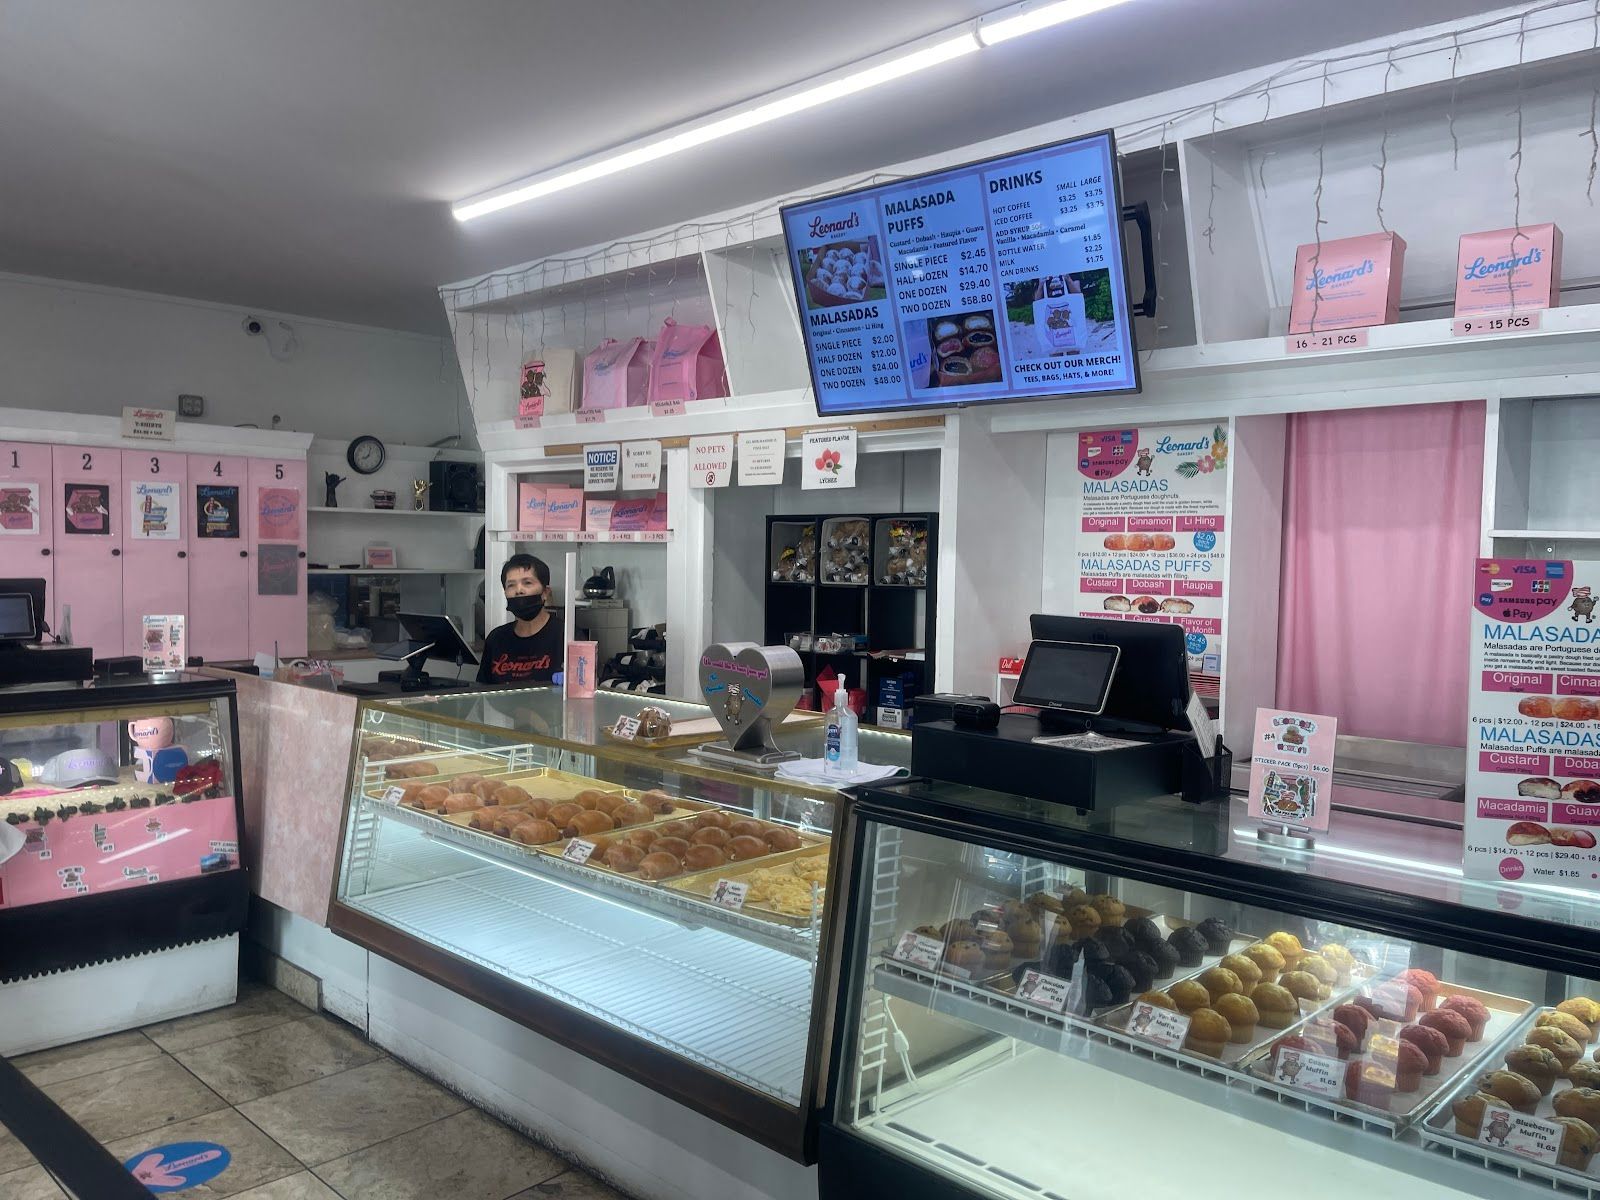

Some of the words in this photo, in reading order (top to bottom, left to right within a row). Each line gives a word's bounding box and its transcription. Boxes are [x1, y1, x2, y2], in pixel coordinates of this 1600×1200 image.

[989, 170, 1043, 194] DRINKS
[1056, 181, 1077, 191] SMALL
[1080, 176, 1101, 186] LARGE
[885, 190, 955, 216] MALASADA
[992, 206, 1006, 214] HOT
[1007, 201, 1031, 211] COFFEE
[1059, 194, 1076, 203] $3.25
[1084, 188, 1103, 198] $3.75
[994, 217, 1008, 226] ICED
[1009, 212, 1033, 223] COFFEE
[1060, 205, 1078, 215] $3.25
[808, 211, 859, 238] Leonard's
[888, 216, 924, 234] PUFFS
[995, 229, 1009, 238] ADD
[1010, 225, 1030, 235] SYRUP
[890, 238, 911, 248] Custard
[966, 225, 984, 234] Guava
[996, 236, 1016, 245] Vanilla
[1021, 229, 1055, 240] Macadamia
[1060, 224, 1086, 234] Caramel
[933, 239, 958, 249] Featured
[998, 246, 1022, 257] BOTTLE
[1022, 243, 1045, 253] WATER
[894, 259, 923, 272] SINGLE
[925, 254, 948, 266] PIECE
[960, 248, 986, 260] $2.45
[999, 258, 1015, 267] MILK
[1084, 244, 1103, 253] $2.25
[1000, 268, 1014, 277] CAN
[1015, 265, 1039, 275] DRINKS
[1086, 255, 1104, 263] $1.75
[1464, 248, 1542, 280] Leonard's
[920, 270, 948, 282] DOZEN
[959, 263, 989, 276] $14.70
[1306, 259, 1373, 290] Leonard's
[899, 289, 916, 300] ONE
[918, 285, 947, 297] DOZEN
[960, 278, 991, 291] $29.40
[901, 304, 920, 314] TWO
[922, 299, 951, 311] DOZEN
[961, 293, 993, 306] $58.80
[810, 306, 879, 327] MALASADAS
[1465, 323, 1471, 332] 9
[1490, 320, 1503, 329] 15
[1507, 318, 1530, 327] PCS
[815, 340, 841, 352] SINGLE
[842, 338, 862, 349] PIECE
[872, 334, 894, 345] $2.00
[1297, 340, 1307, 348] 16
[1322, 337, 1332, 345] 21
[1338, 335, 1357, 344] PCS
[818, 354, 836, 365] HALF
[837, 352, 863, 362] DOZEN
[871, 348, 897, 359] $12.00
[1014, 363, 1042, 373] CHECK
[1043, 361, 1061, 370] OUT
[1064, 359, 1083, 368] OUR
[1086, 355, 1121, 366] MERCH!
[820, 368, 836, 377] ONE
[838, 365, 862, 375] DOZEN
[872, 362, 899, 372] $24.00
[1023, 376, 1040, 384] TEES,
[1042, 374, 1061, 382] BAGS,
[1063, 372, 1083, 380] HATS,
[1091, 369, 1115, 377] MORE!
[822, 381, 839, 390] TWO
[841, 379, 866, 389] DOZEN
[874, 375, 901, 385] $48.00
[810, 436, 832, 444] FEATURED
[1156, 436, 1210, 454] Leonard's
[707, 445, 725, 453] PETS
[12, 451, 20, 468] 1
[82, 454, 92, 470] 2
[150, 458, 160, 473] 3
[588, 452, 616, 464] NOTICE
[213, 461, 223, 477] 4
[275, 464, 283, 480] 5
[694, 462, 727, 471] ALLOWED
[1083, 479, 1169, 494] MALASADAS
[1088, 517, 1119, 528] Original
[1129, 516, 1172, 526] Cinnamon
[1184, 517, 1193, 525] Li
[1195, 516, 1216, 527] Hing
[1081, 559, 1161, 571] MALASADAS
[1165, 560, 1211, 573] PUFFS
[1513, 565, 1536, 574] VISA
[1086, 578, 1117, 587] Custard
[1132, 579, 1165, 588] Dobash
[1182, 581, 1213, 591] Haupia
[1513, 609, 1533, 621] Pay
[1484, 642, 1528, 651] Malasadas
[1545, 645, 1592, 654] Portuguese
[492, 653, 550, 673] Leonard's
[1493, 672, 1542, 686] Original
[1498, 717, 1523, 725] $12.00
[1480, 743, 1524, 751] Malasadas
[1526, 745, 1547, 754] Puffs
[1254, 757, 1276, 765] STICKER
[1490, 753, 1540, 766] Custard
[1479, 800, 1546, 814] Macadamia
[1493, 846, 1518, 855] $14.70
[1555, 851, 1580, 860] $29.40
[1533, 867, 1555, 876] Water
[1559, 869, 1580, 878] $1.85
[1040, 979, 1064, 989] Chocolate
[1042, 985, 1058, 994] Muffin
[1156, 1019, 1174, 1030] Muffin
[1309, 1059, 1329, 1067] Guava
[1306, 1066, 1329, 1076] Muffin
[1320, 1078, 1337, 1086] $1.65
[1515, 1118, 1555, 1135] Blueberry
[1520, 1129, 1547, 1140] Muffin
[1537, 1142, 1556, 1152] $1.65
